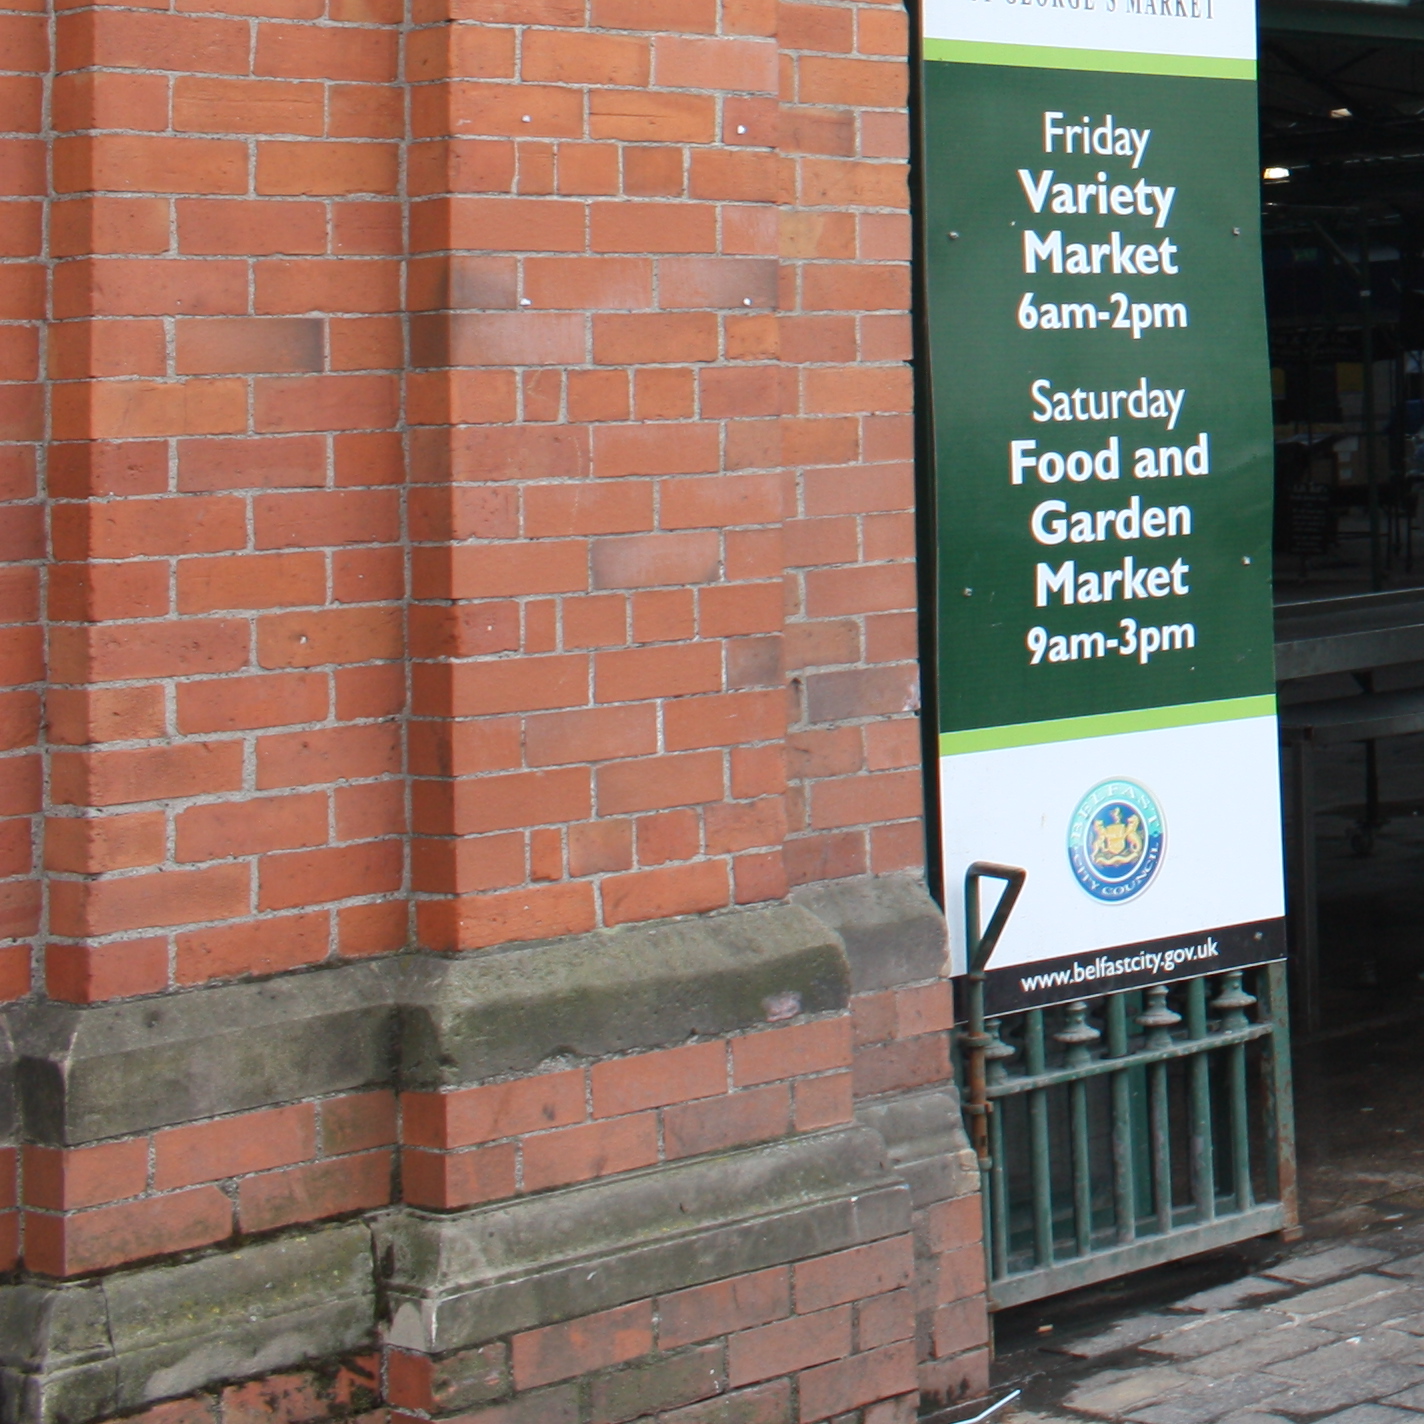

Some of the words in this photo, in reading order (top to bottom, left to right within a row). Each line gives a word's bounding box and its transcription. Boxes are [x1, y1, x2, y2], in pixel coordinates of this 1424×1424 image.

[1043, 111, 1151, 168] Friday
[1018, 169, 1176, 228] Variety
[1024, 230, 1179, 275] Market
[1018, 292, 1188, 340] 6am-2pm
[1031, 377, 1186, 430] Saturday
[1010, 436, 1120, 485] Food
[1134, 433, 1209, 479] and
[1031, 495, 1191, 546] Garden
[1036, 555, 1190, 607] Market
[1027, 618, 1195, 665] 9am-3pm
[1071, 784, 1160, 838] BELFAST
[1102, 843, 1160, 895] COUNCIL
[1021, 937, 1219, 992] www.belfastcity.gov.uk
